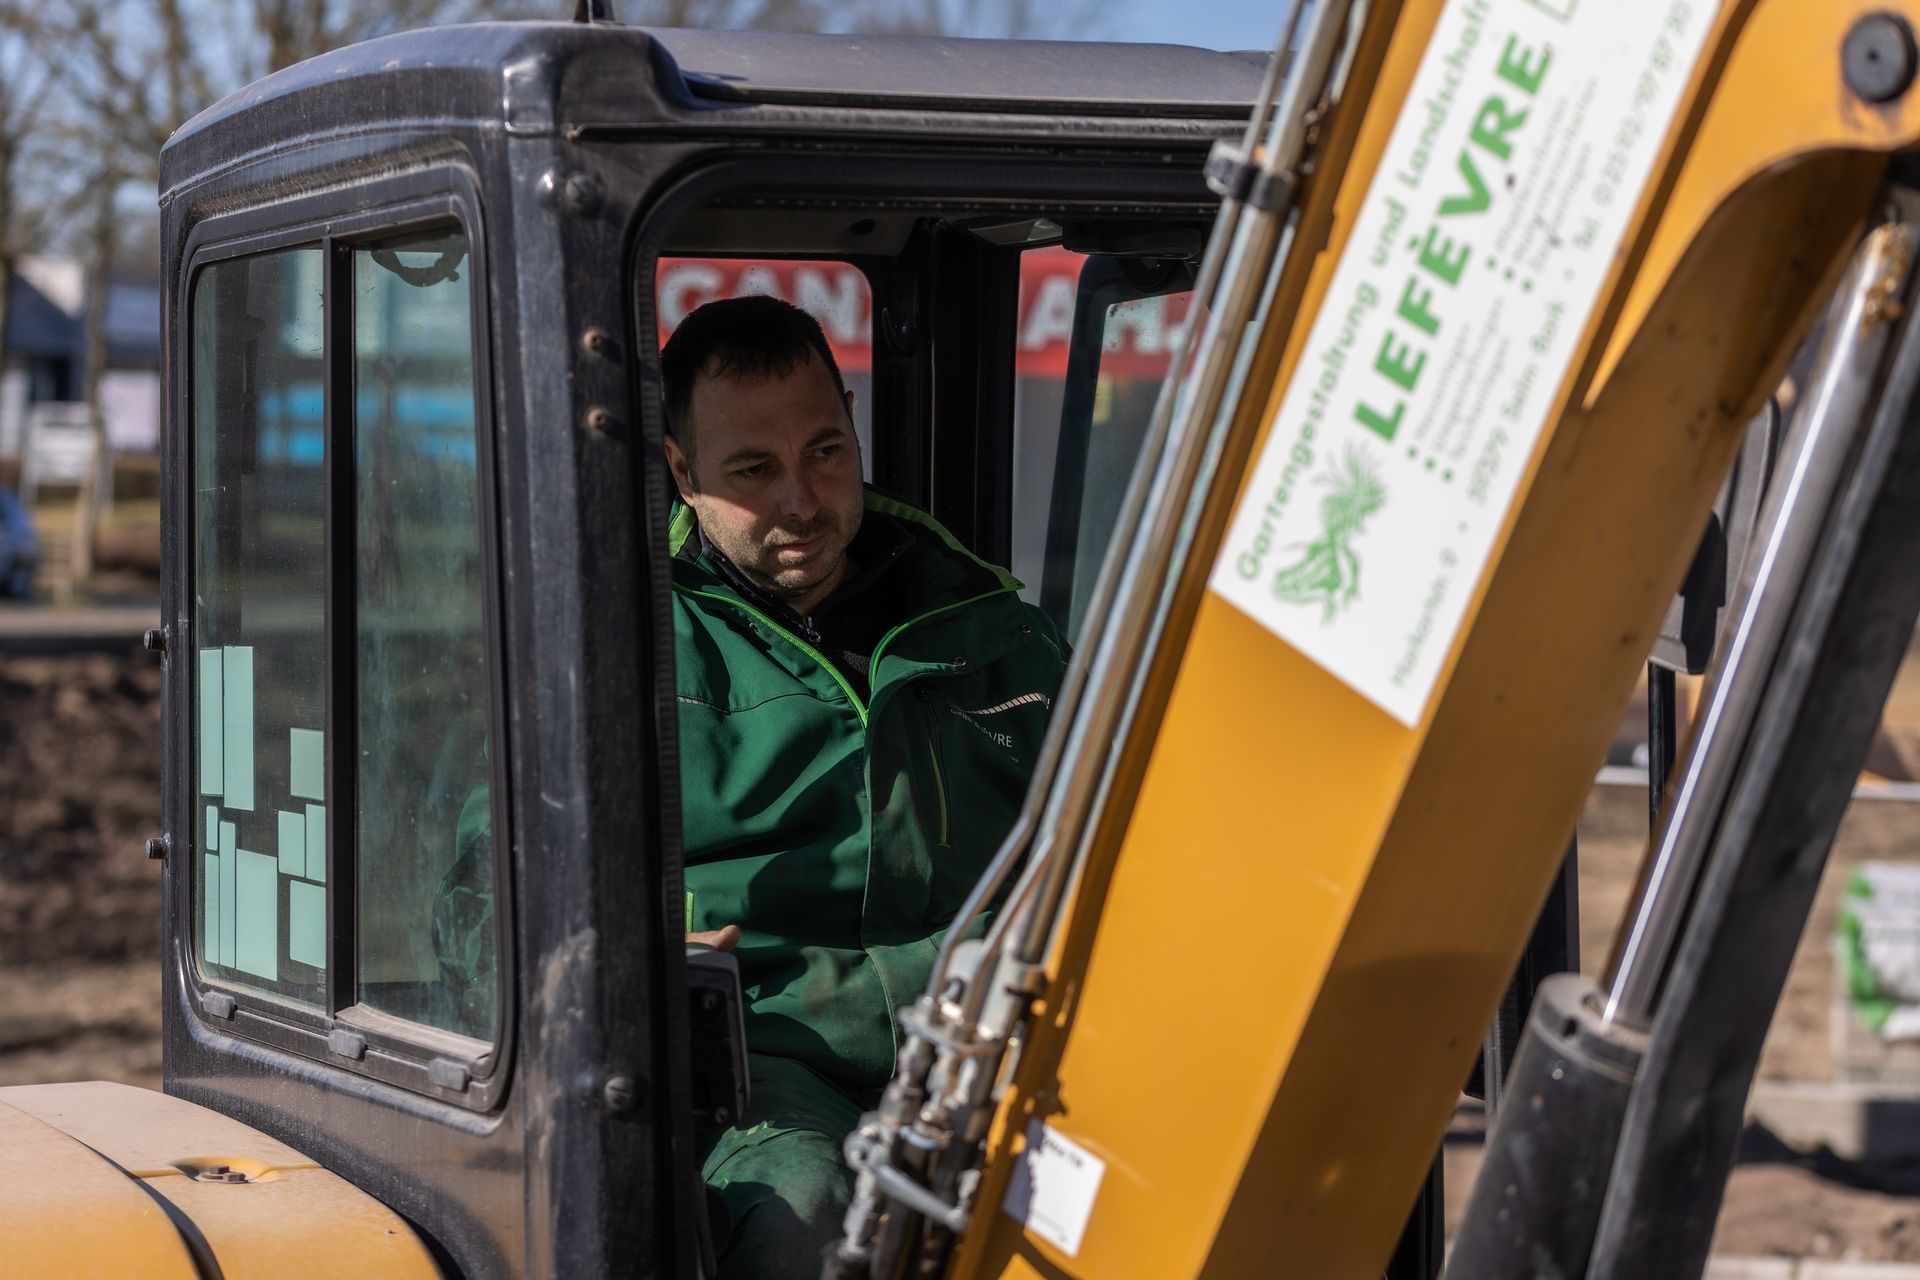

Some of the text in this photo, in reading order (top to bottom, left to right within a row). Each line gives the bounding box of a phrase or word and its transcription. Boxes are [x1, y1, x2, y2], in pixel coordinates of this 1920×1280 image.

[1236, 281, 1380, 582] Gartengestaltung
[1370, 196, 1408, 268] und
[1352, 35, 1552, 443] LEFÈVRE
